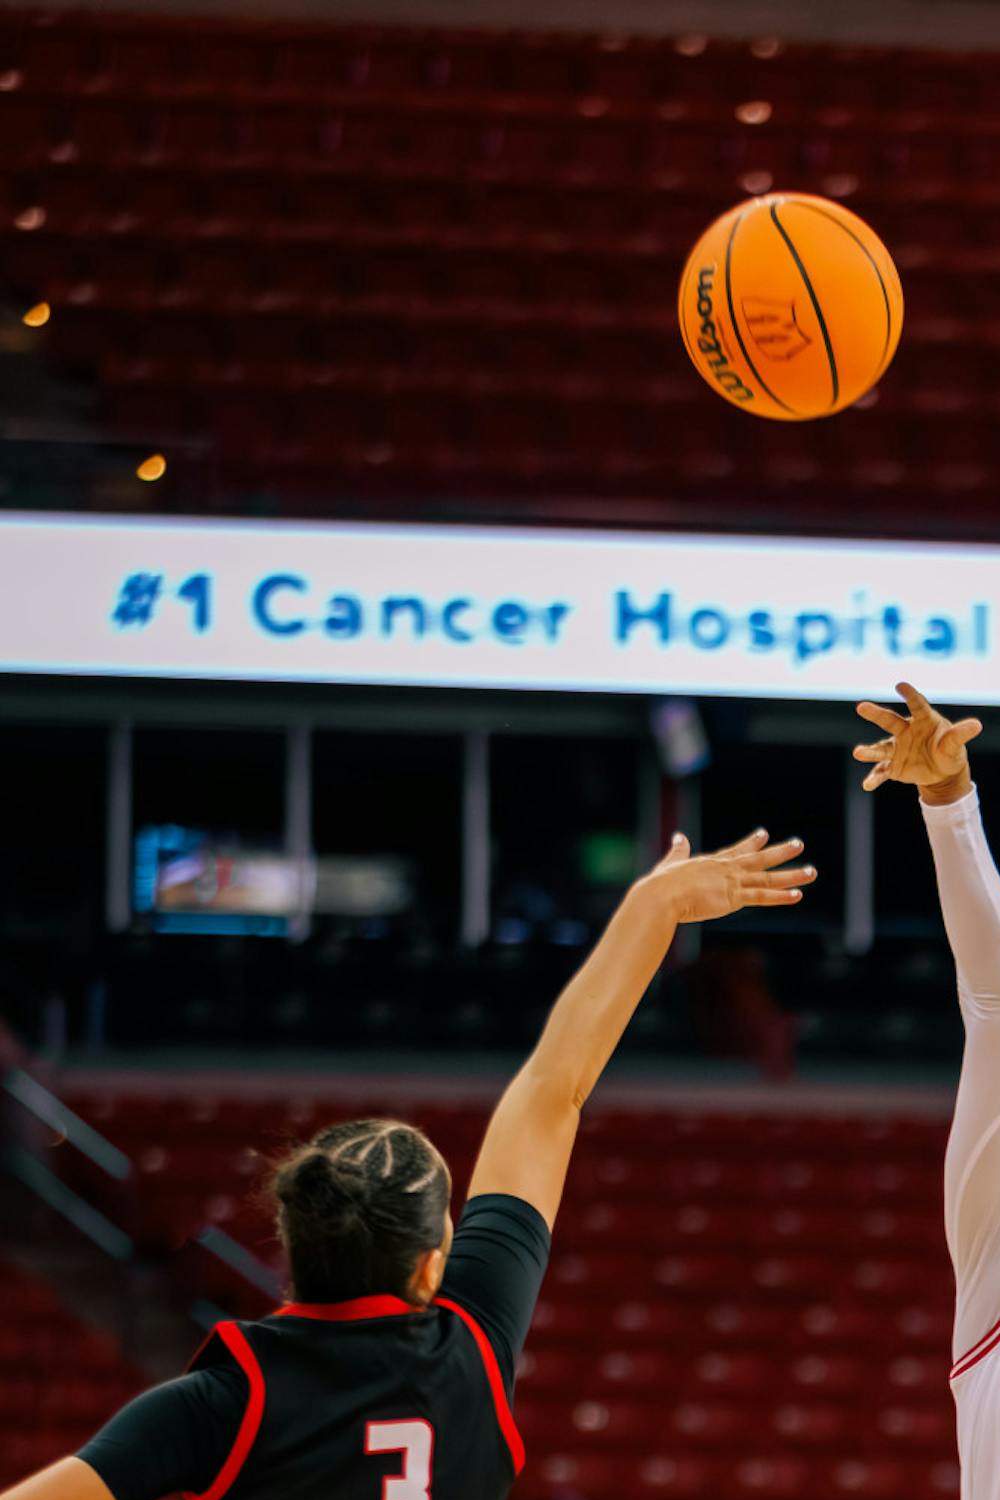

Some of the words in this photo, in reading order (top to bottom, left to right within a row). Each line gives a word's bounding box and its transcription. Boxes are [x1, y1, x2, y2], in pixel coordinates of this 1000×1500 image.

[112, 571, 213, 633] #1
[252, 573, 571, 643] Cancer
[613, 589, 989, 662] Hospital
